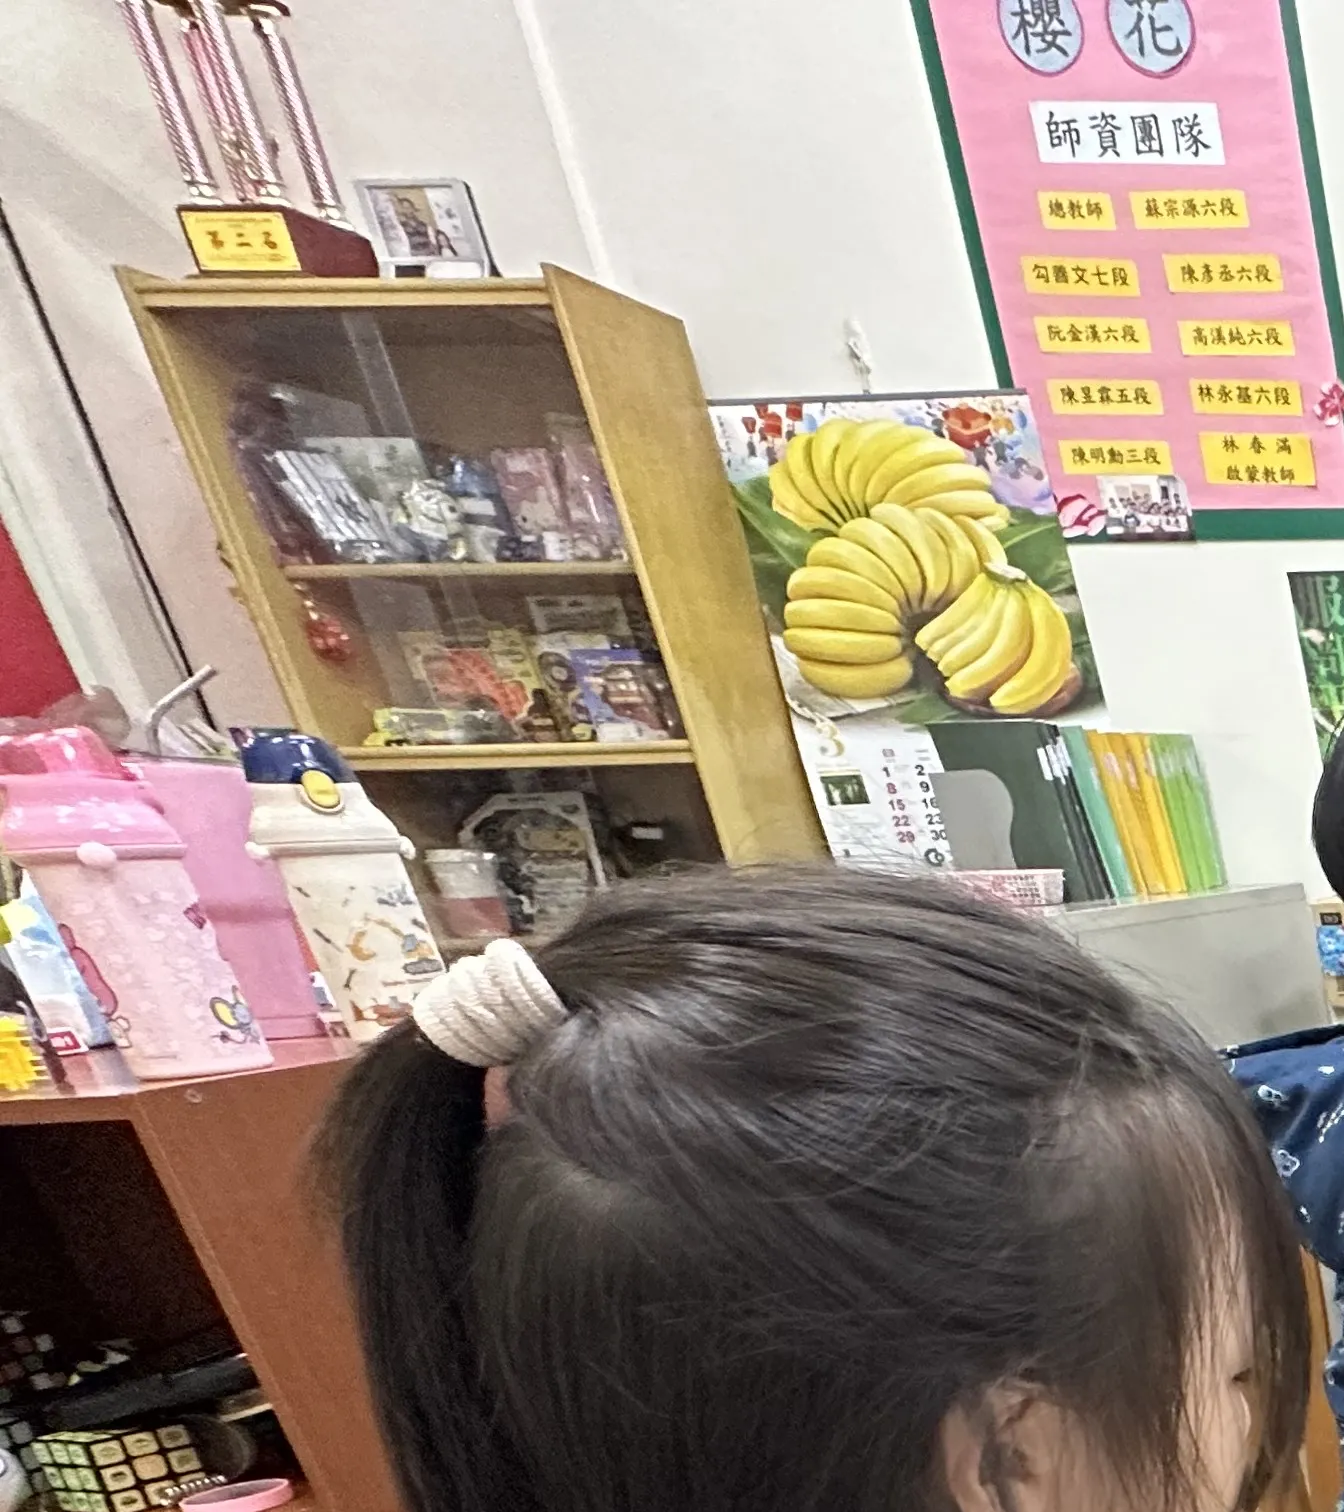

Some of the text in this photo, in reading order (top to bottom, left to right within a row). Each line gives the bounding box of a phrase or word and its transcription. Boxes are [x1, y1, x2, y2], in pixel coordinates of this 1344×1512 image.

[1045, 110, 1211, 158] 師資團隊
[1048, 198, 1103, 220] 總教師
[1145, 197, 1238, 218] 蘇宗源六段
[882, 764, 926, 778] 1 2
[886, 781, 930, 795] 8 9
[888, 799, 906, 811] 15
[892, 815, 911, 827] 22
